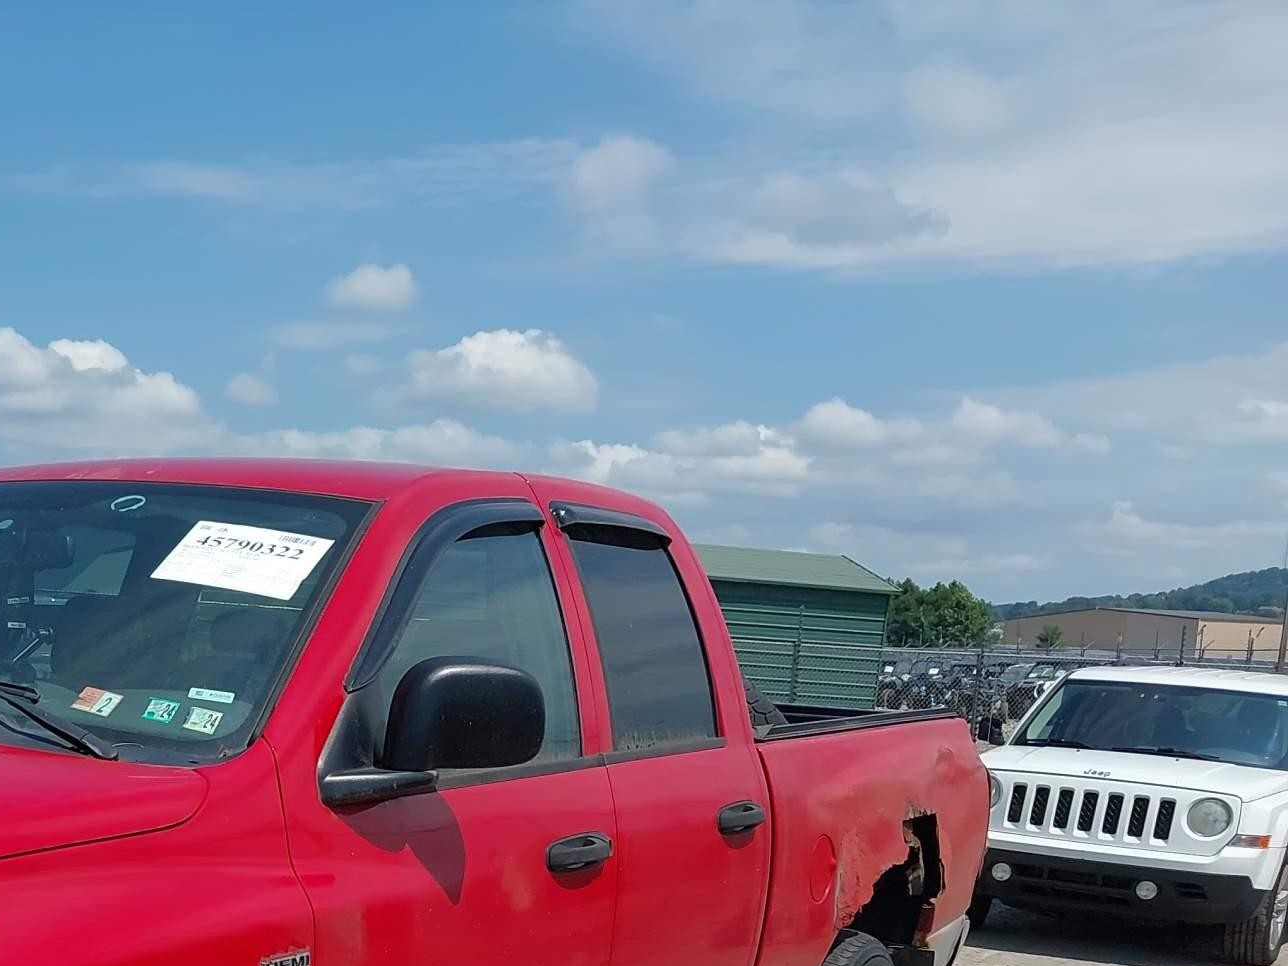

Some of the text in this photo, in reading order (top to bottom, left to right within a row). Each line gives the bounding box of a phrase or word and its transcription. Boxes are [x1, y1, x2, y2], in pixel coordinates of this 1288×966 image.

[196, 535, 305, 561] 45790322
[96, 697, 113, 713] 2
[160, 703, 177, 719] 24
[203, 713, 219, 730] 24
